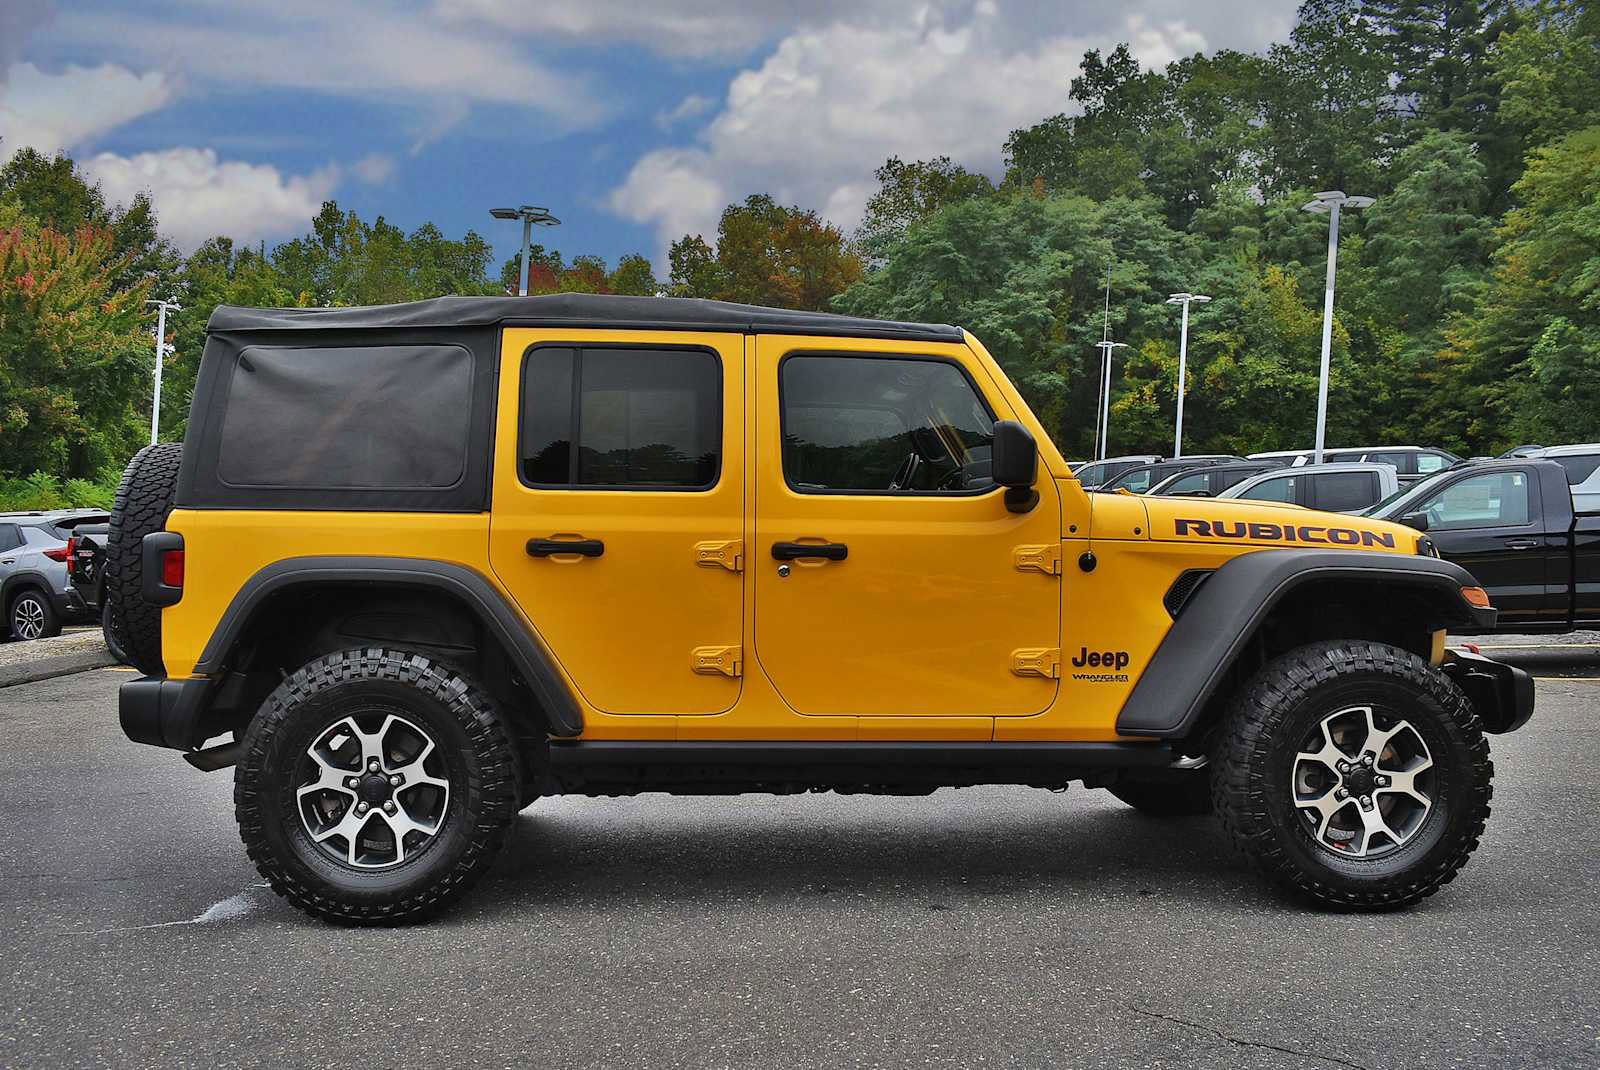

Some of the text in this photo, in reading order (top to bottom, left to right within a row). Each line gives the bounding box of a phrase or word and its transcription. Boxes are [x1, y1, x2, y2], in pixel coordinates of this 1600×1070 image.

[1174, 518, 1396, 548] RUBICON
[1071, 647, 1129, 671] Jeep
[1072, 673, 1129, 681] WRANGLER
